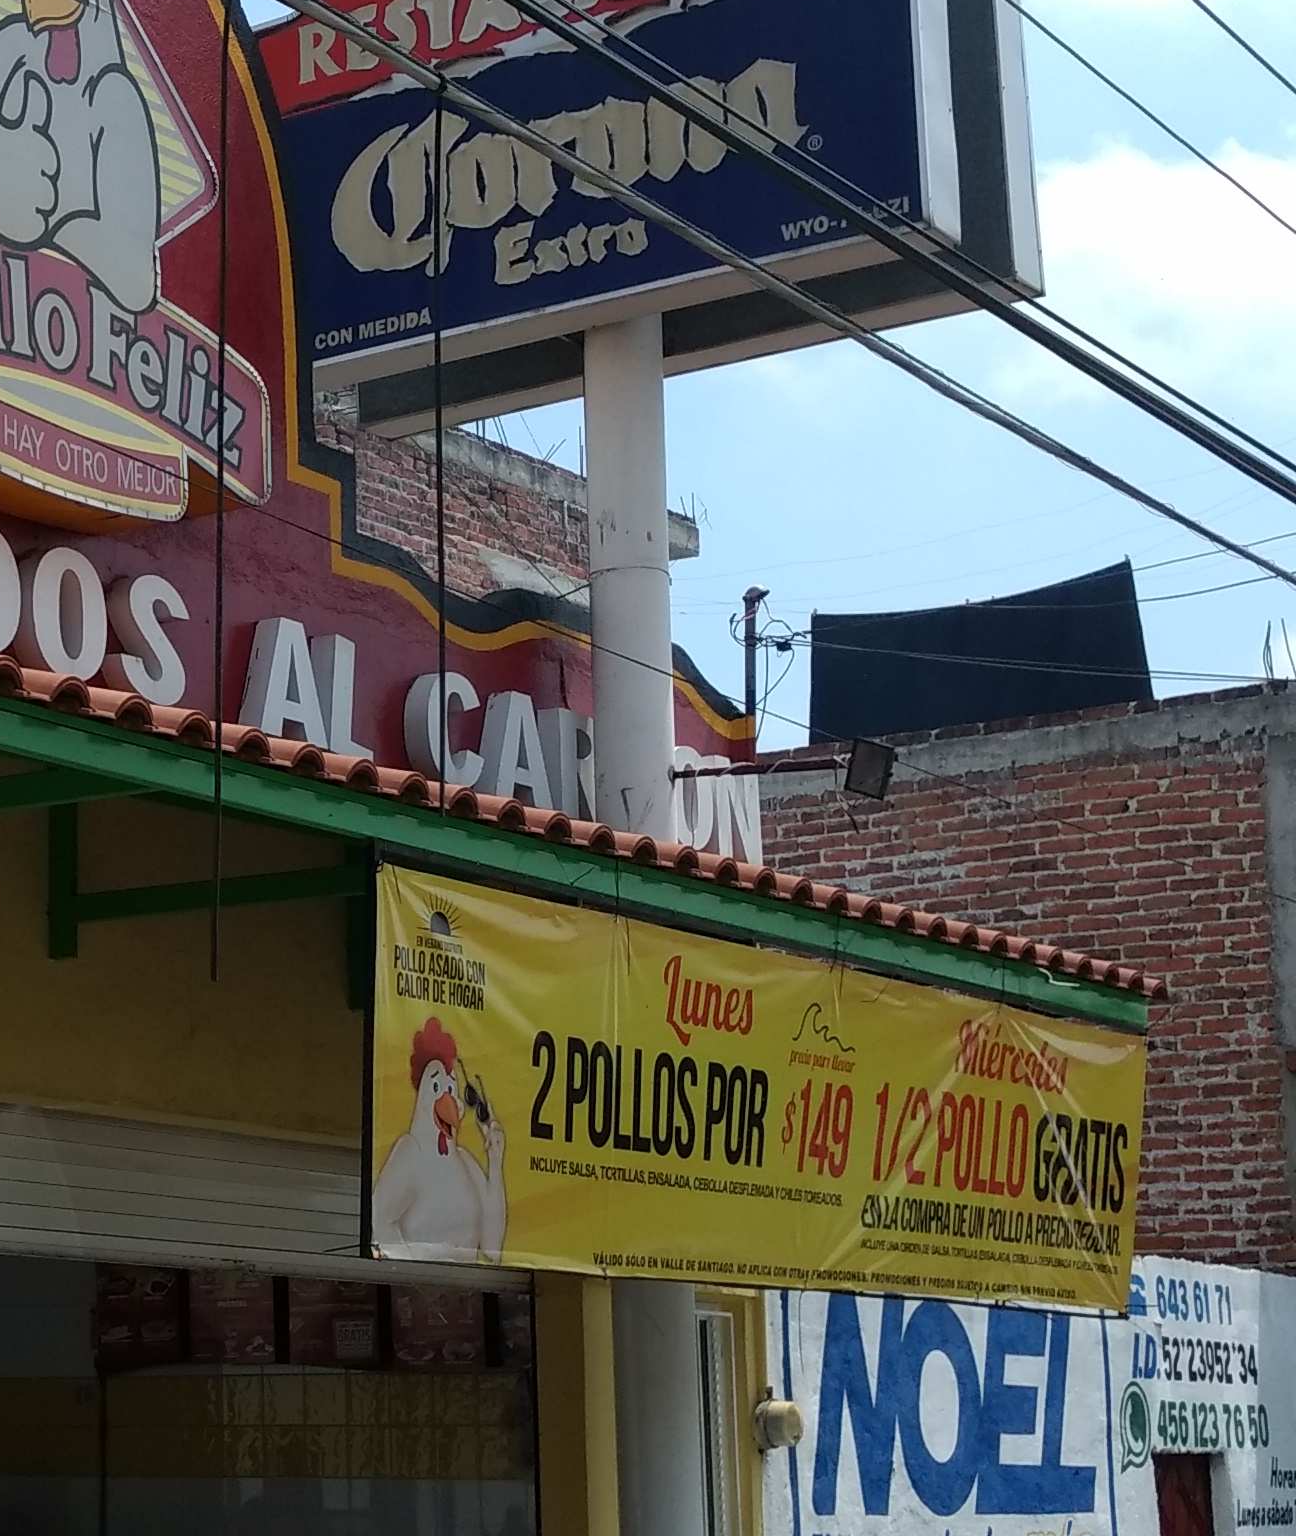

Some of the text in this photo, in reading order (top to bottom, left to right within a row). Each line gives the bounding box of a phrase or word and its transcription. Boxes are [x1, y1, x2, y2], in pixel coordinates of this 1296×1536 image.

[330, 57, 810, 278] Corona
[494, 217, 649, 286] Extra
[314, 306, 433, 350] CON MEDIDA
[88, 278, 246, 471] Feliz
[3, 412, 47, 462] HAY
[55, 440, 109, 484] OTRO
[117, 462, 179, 498] MEJOR
[238, 616, 374, 761] AL
[404, 671, 763, 865] CARON
[394, 944, 486, 986] POLLO ASADO CON
[397, 971, 484, 1011] CALOR DE HOGAR
[663, 955, 754, 1047] Lunes
[789, 1048, 812, 1067] precio
[530, 1030, 557, 1141] 2
[565, 1036, 699, 1159] POLLOS
[703, 1061, 769, 1169] POR
[871, 1082, 1129, 1214] 1/2 POLLO GRATIS
[530, 1156, 844, 1207] INCLUYE SALSA, TORTILLAS, ENSALADA, CEBOLLA DESFLEMADA Y CHILES TOREADOS.
[861, 1194, 882, 1229] EN
[882, 1195, 900, 1230] LA
[901, 1197, 951, 1236] COMPRA
[952, 1203, 968, 1238] DE
[968, 1205, 985, 1240] UN
[986, 1207, 1023, 1243] POLLO
[1024, 1212, 1033, 1245] A
[1035, 1214, 1073, 1249] PRECIO
[593, 1251, 623, 1266] VÁLIDO
[626, 1253, 646, 1268] SÓLO
[648, 1256, 658, 1269] EN
[660, 1257, 684, 1271] VALLE
[686, 1259, 696, 1272] DE
[736, 1263, 746, 1274] NO
[748, 1264, 772, 1277] APLICA
[773, 1266, 787, 1277] CON
[1156, 1274, 1232, 1325] 643 61 71
[812, 1294, 1098, 1517] NOEL
[1157, 1399, 1270, 1449] 456 123 76 50
[1237, 1499, 1260, 1527] Lunes
